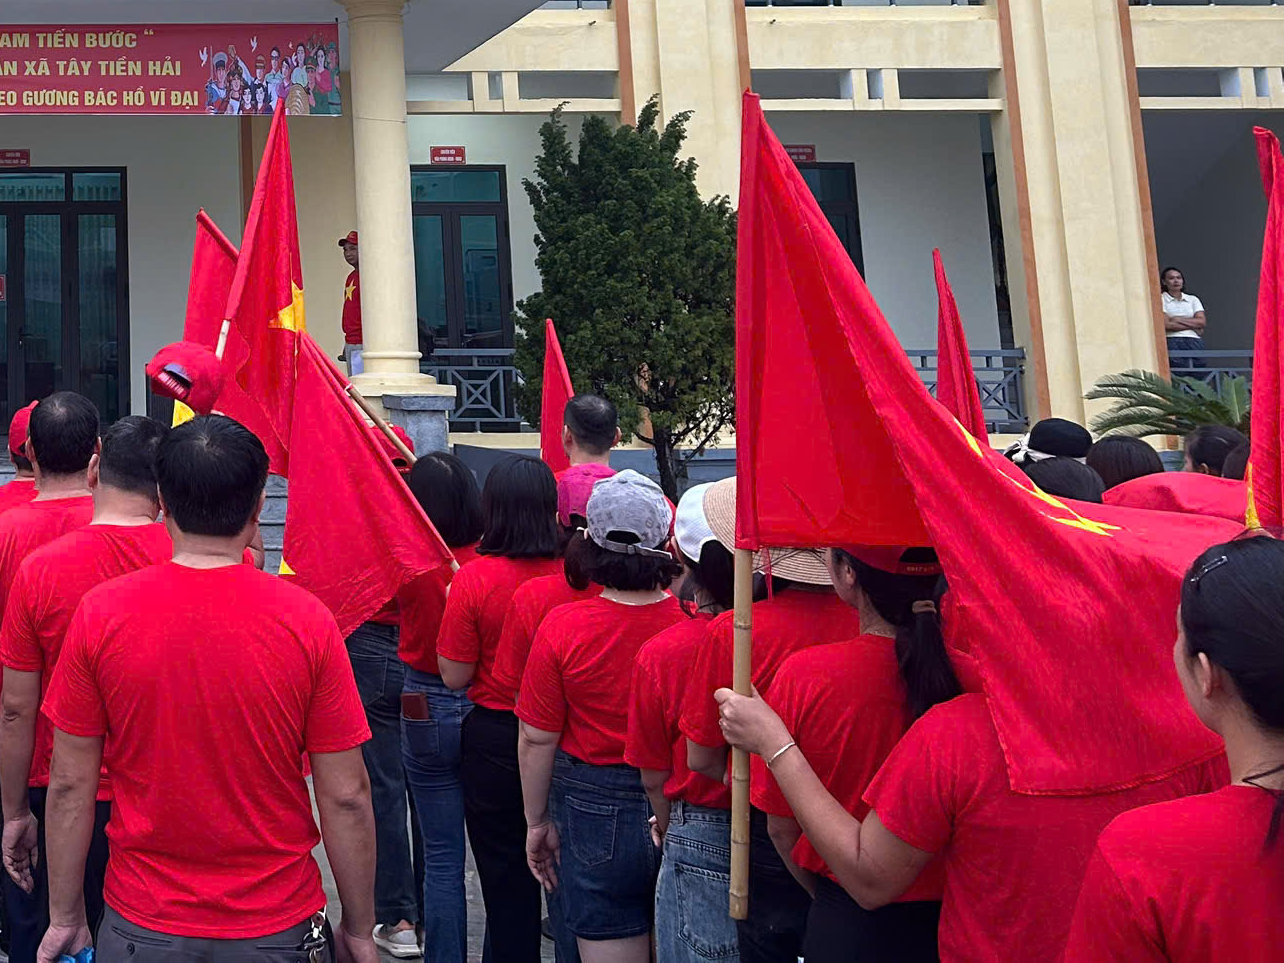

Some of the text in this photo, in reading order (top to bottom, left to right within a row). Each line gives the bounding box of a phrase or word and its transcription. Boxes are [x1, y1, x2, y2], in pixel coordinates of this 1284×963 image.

[35, 28, 79, 48] TIẾN
[85, 29, 137, 48] BƯỚC
[23, 57, 51, 76] XÃ
[55, 57, 92, 76] TÂY
[97, 55, 143, 76] TIỀN
[148, 55, 181, 76] HẢI
[22, 89, 79, 106] GƯƠNG
[84, 87, 118, 106] BÁC
[122, 85, 146, 106] HỒ
[149, 87, 167, 106] VĨ
[170, 90, 199, 110] ĐẠI
